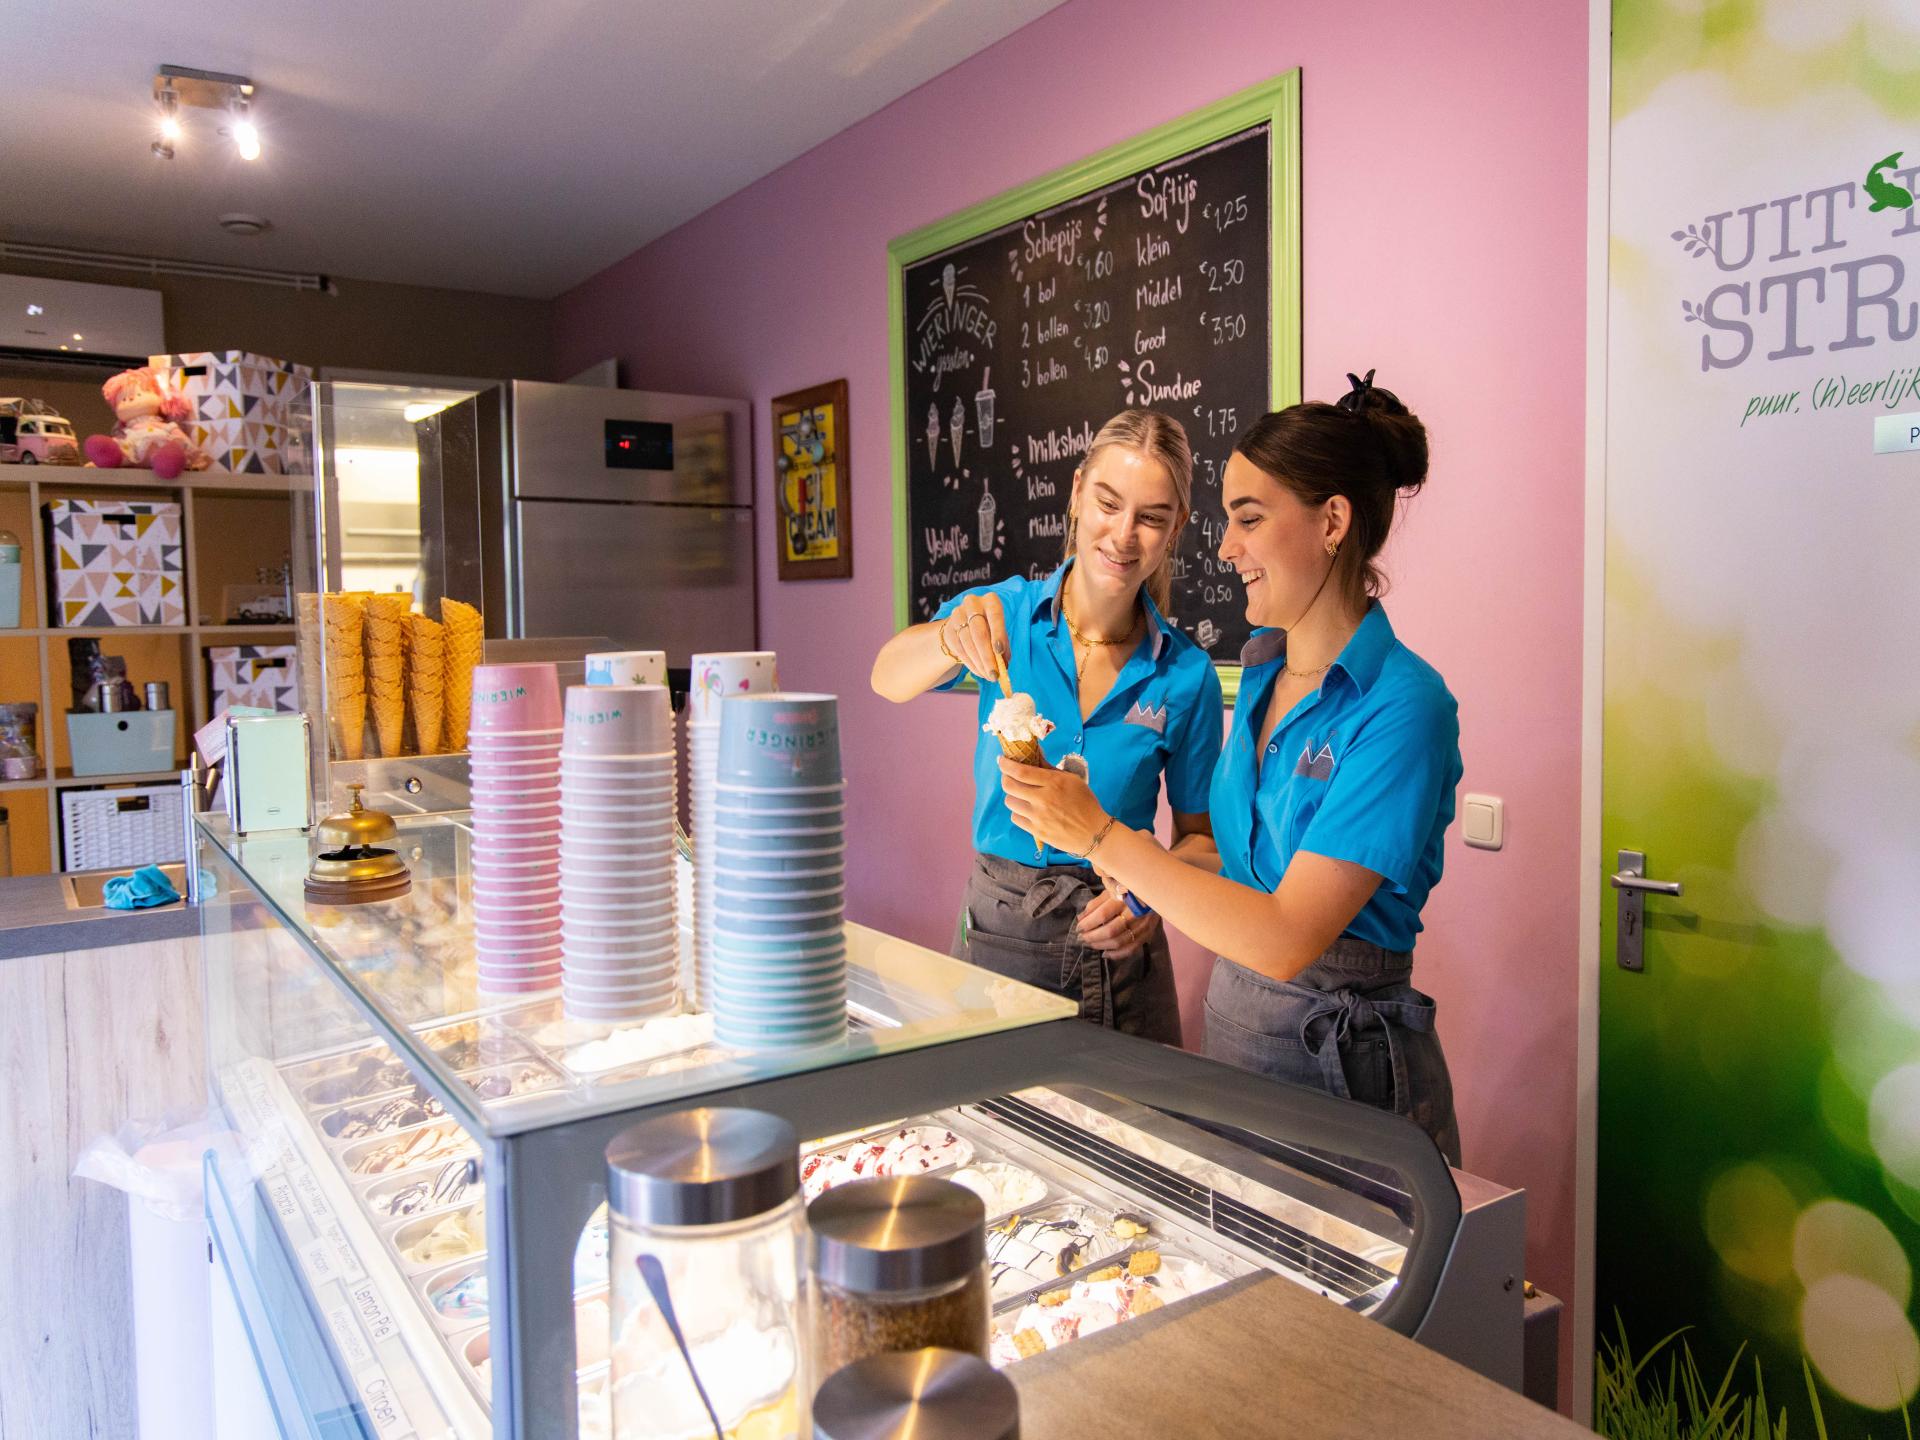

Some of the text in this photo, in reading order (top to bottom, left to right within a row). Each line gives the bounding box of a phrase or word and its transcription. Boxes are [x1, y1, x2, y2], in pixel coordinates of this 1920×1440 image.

[1704, 181, 1856, 272] UIT
[1137, 233, 1170, 267] klein
[1038, 277, 1056, 304] bol
[1136, 275, 1183, 311] Middel
[1702, 254, 1919, 373] STR
[912, 301, 998, 372] WIERINGER
[1022, 321, 1031, 349] 2
[1037, 315, 1069, 345] bollen
[1135, 325, 1166, 355] Groot
[1022, 358, 1031, 388] 3
[1037, 357, 1068, 386] bollen
[1137, 360, 1202, 406] Sundae
[1027, 420, 1094, 464] Milkshak
[1027, 475, 1056, 500] klein
[1028, 513, 1068, 539] Middel
[354, 1283, 392, 1339] Lemon Pie
[365, 1378, 397, 1429] Citroen
